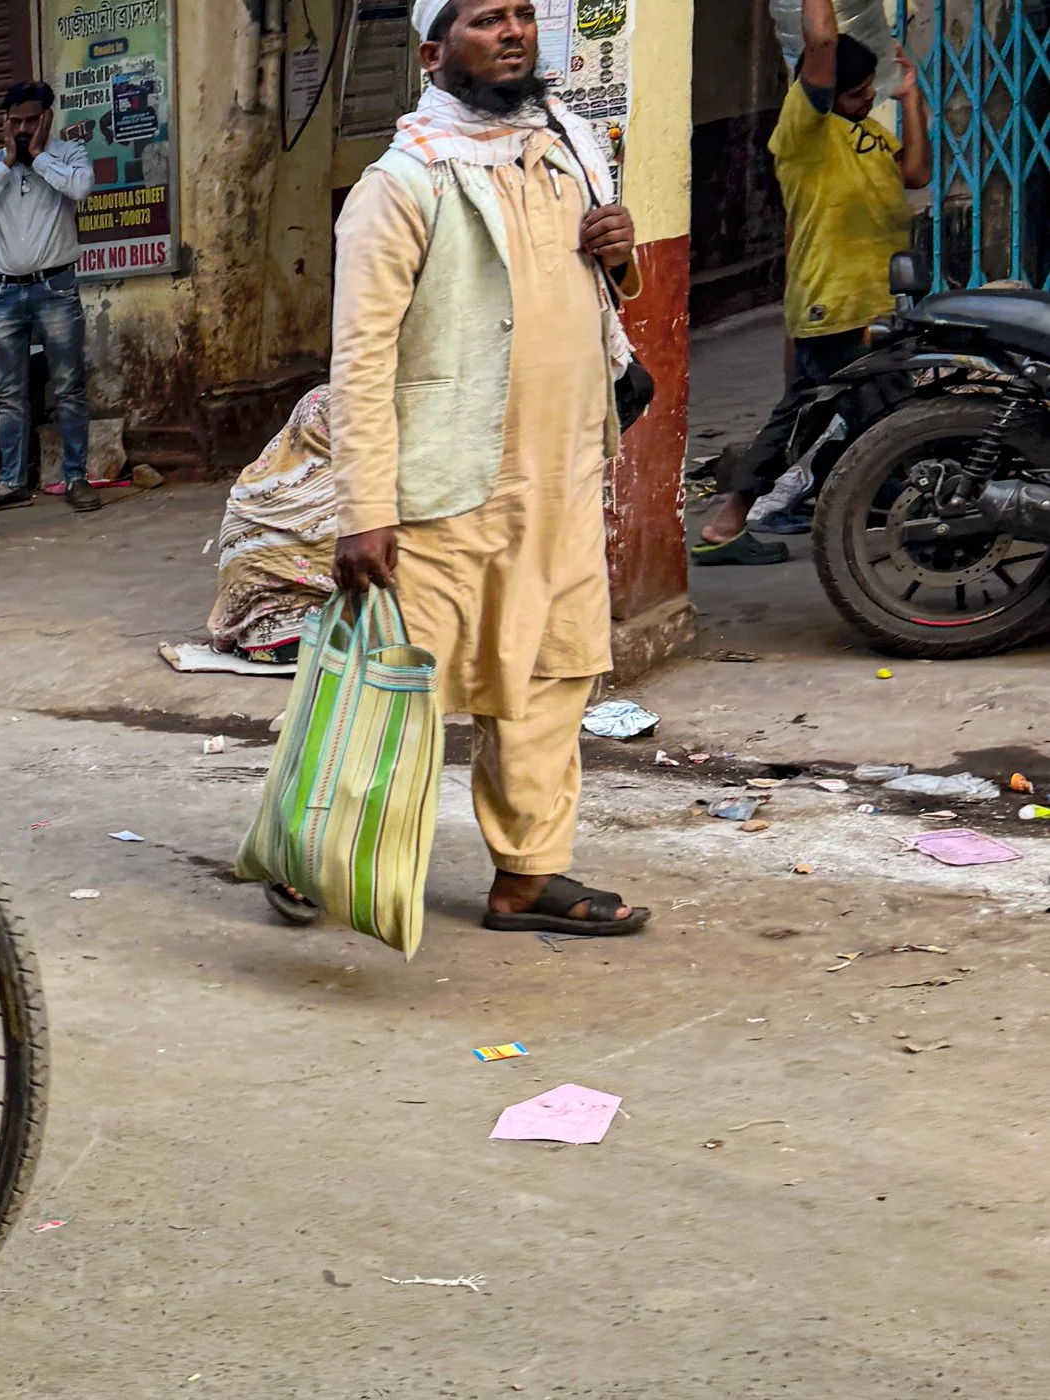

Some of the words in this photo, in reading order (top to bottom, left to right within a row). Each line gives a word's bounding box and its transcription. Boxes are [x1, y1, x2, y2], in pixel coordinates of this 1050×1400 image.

[83, 89, 105, 107] Purse
[134, 186, 165, 206] STREET
[78, 212, 114, 232] KOLKATA
[119, 208, 151, 227] 700073
[76, 247, 106, 273] TICK
[108, 246, 127, 269] NO
[130, 241, 166, 267] BILLS
